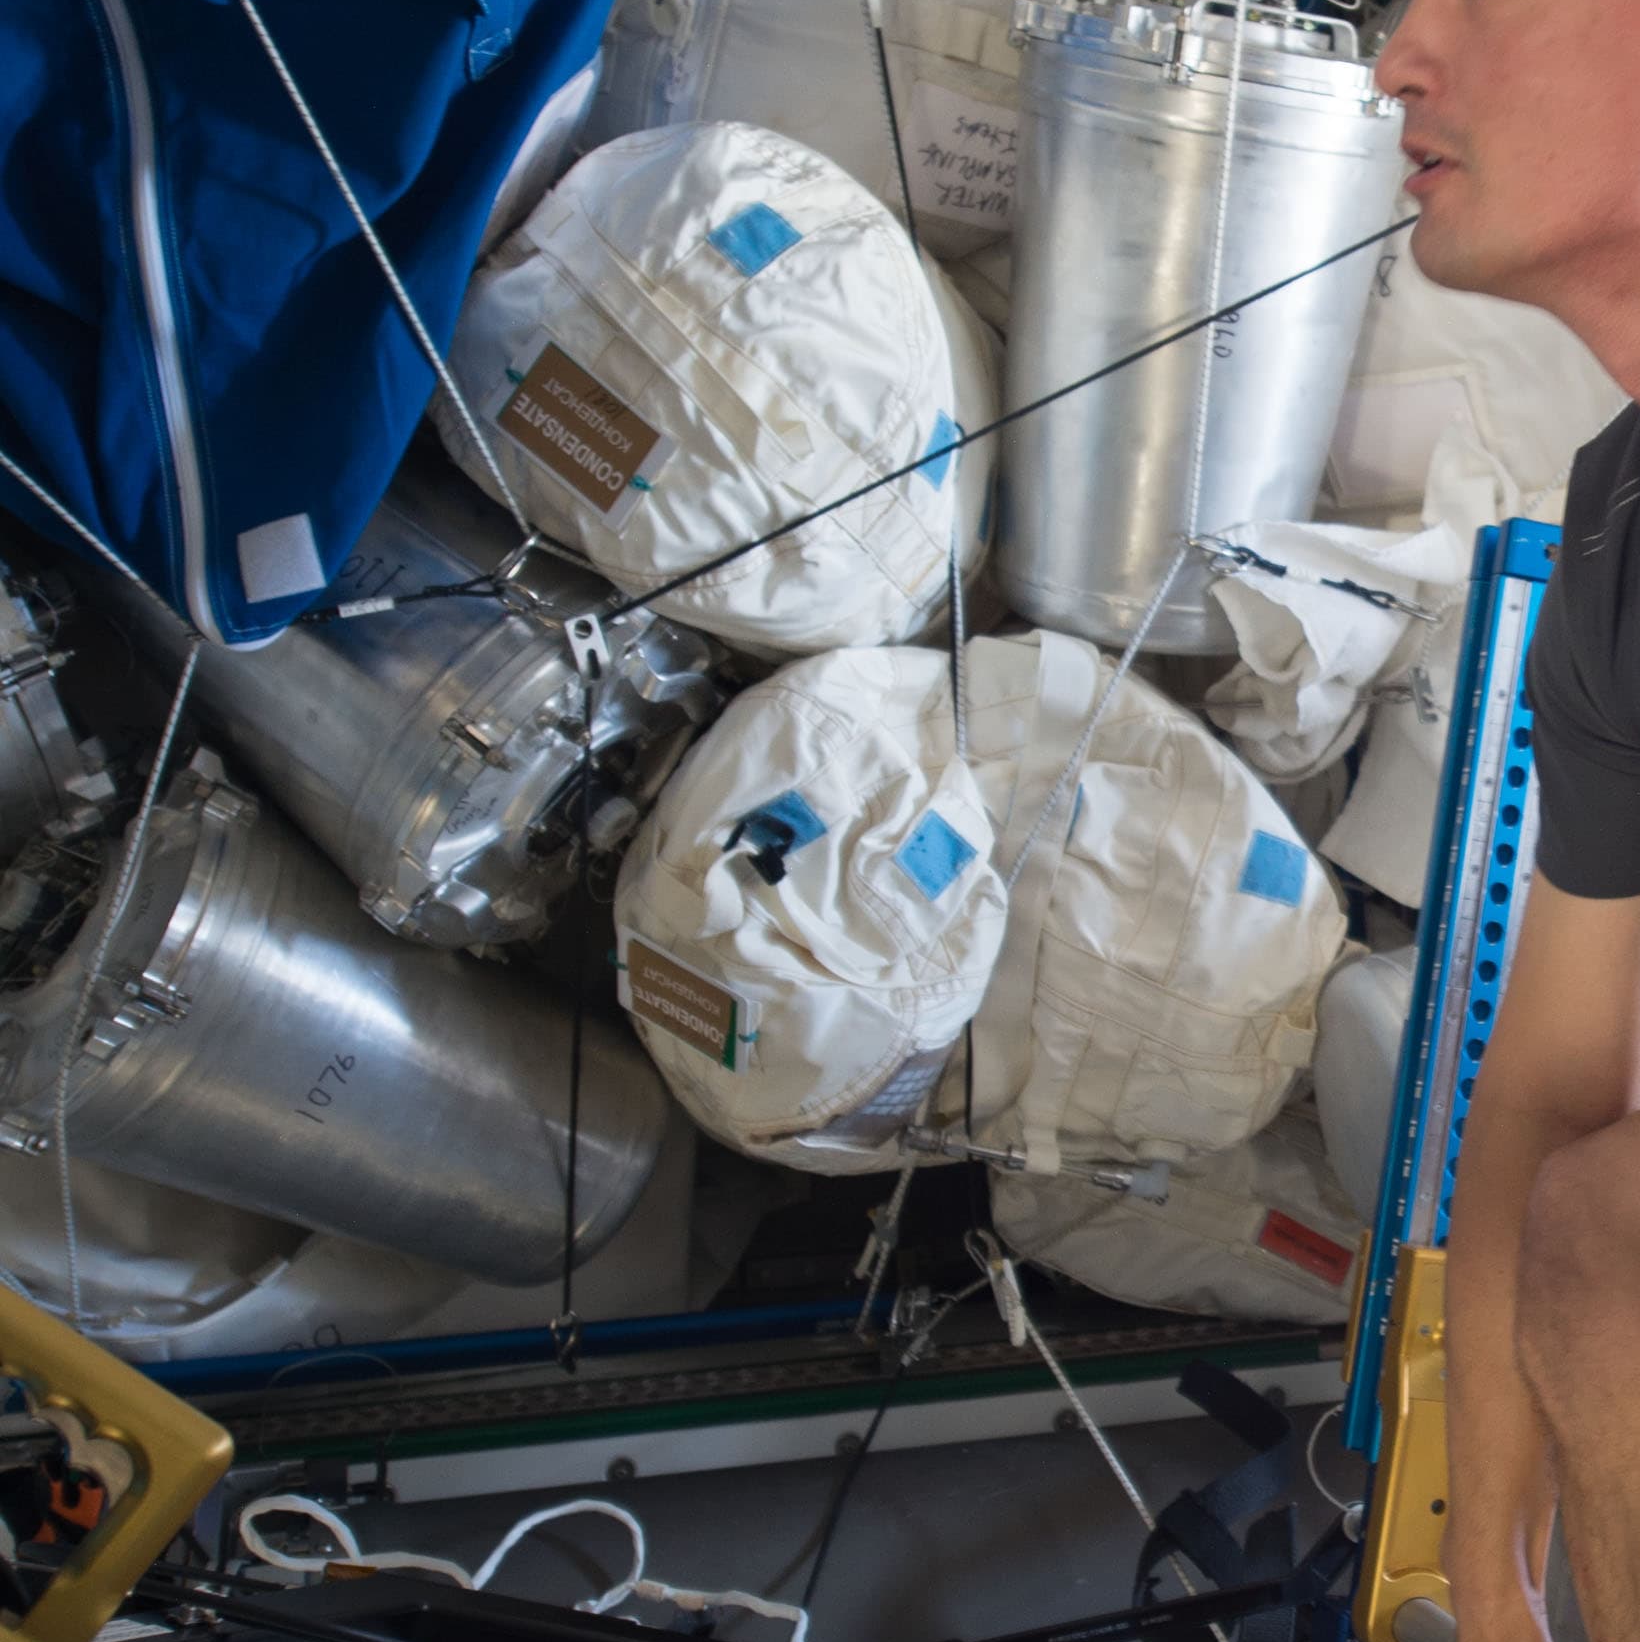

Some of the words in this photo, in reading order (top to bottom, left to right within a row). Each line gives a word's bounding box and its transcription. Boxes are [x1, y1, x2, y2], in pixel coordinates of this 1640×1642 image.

[932, 177, 1010, 217] WATER
[511, 391, 624, 491] CONDENSATE
[544, 376, 633, 454] КОНДЕНСАТ
[295, 1051, 358, 1125] 1076
